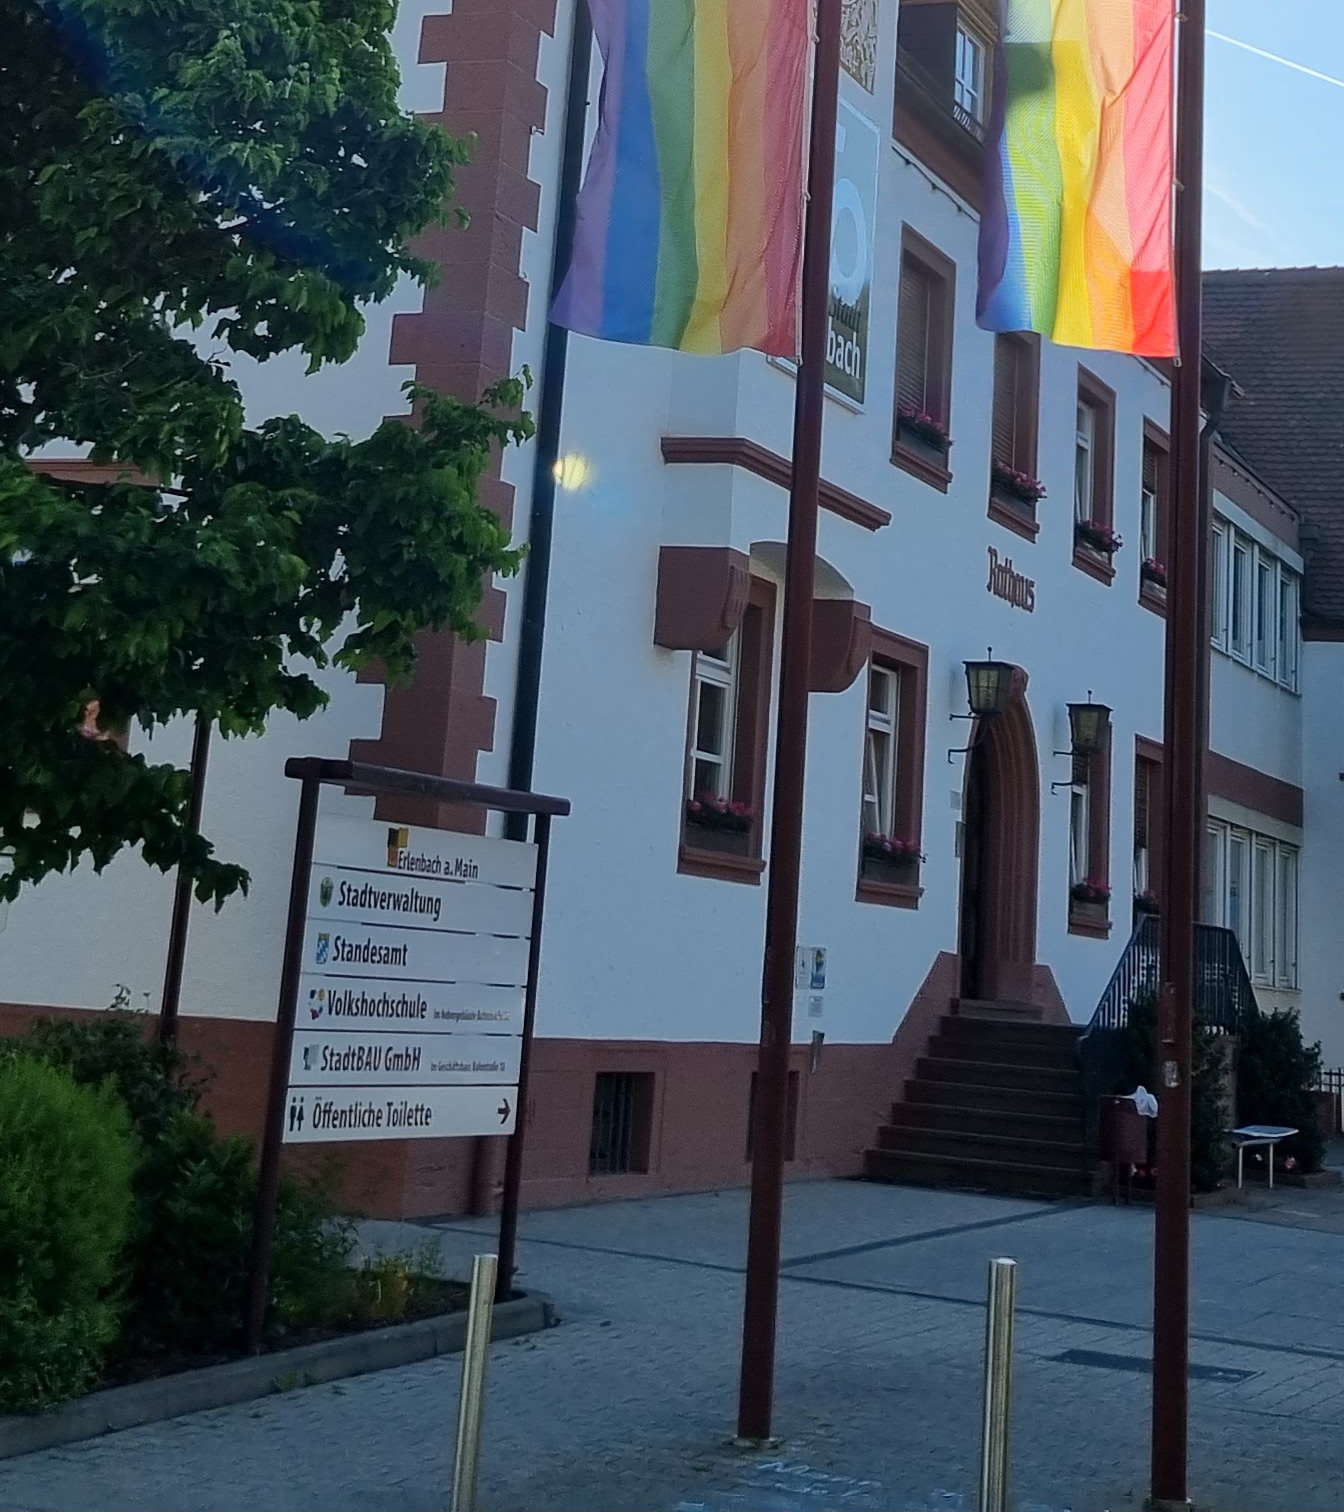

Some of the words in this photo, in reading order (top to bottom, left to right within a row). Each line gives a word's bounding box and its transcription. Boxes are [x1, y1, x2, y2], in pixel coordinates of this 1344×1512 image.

[825, 315, 861, 379] bach
[986, 545, 1036, 614] Rathaus
[398, 850, 442, 875] Erlenbach
[454, 857, 479, 879] Main
[338, 880, 442, 922] Stadtverwaltung
[332, 935, 408, 967] Standesamt
[327, 989, 427, 1020] Volkshochschule
[320, 1045, 383, 1073] StadtBAU
[385, 1046, 422, 1073] GmbH
[312, 1096, 383, 1130] Öffentliche
[386, 1100, 433, 1128] Toilette
